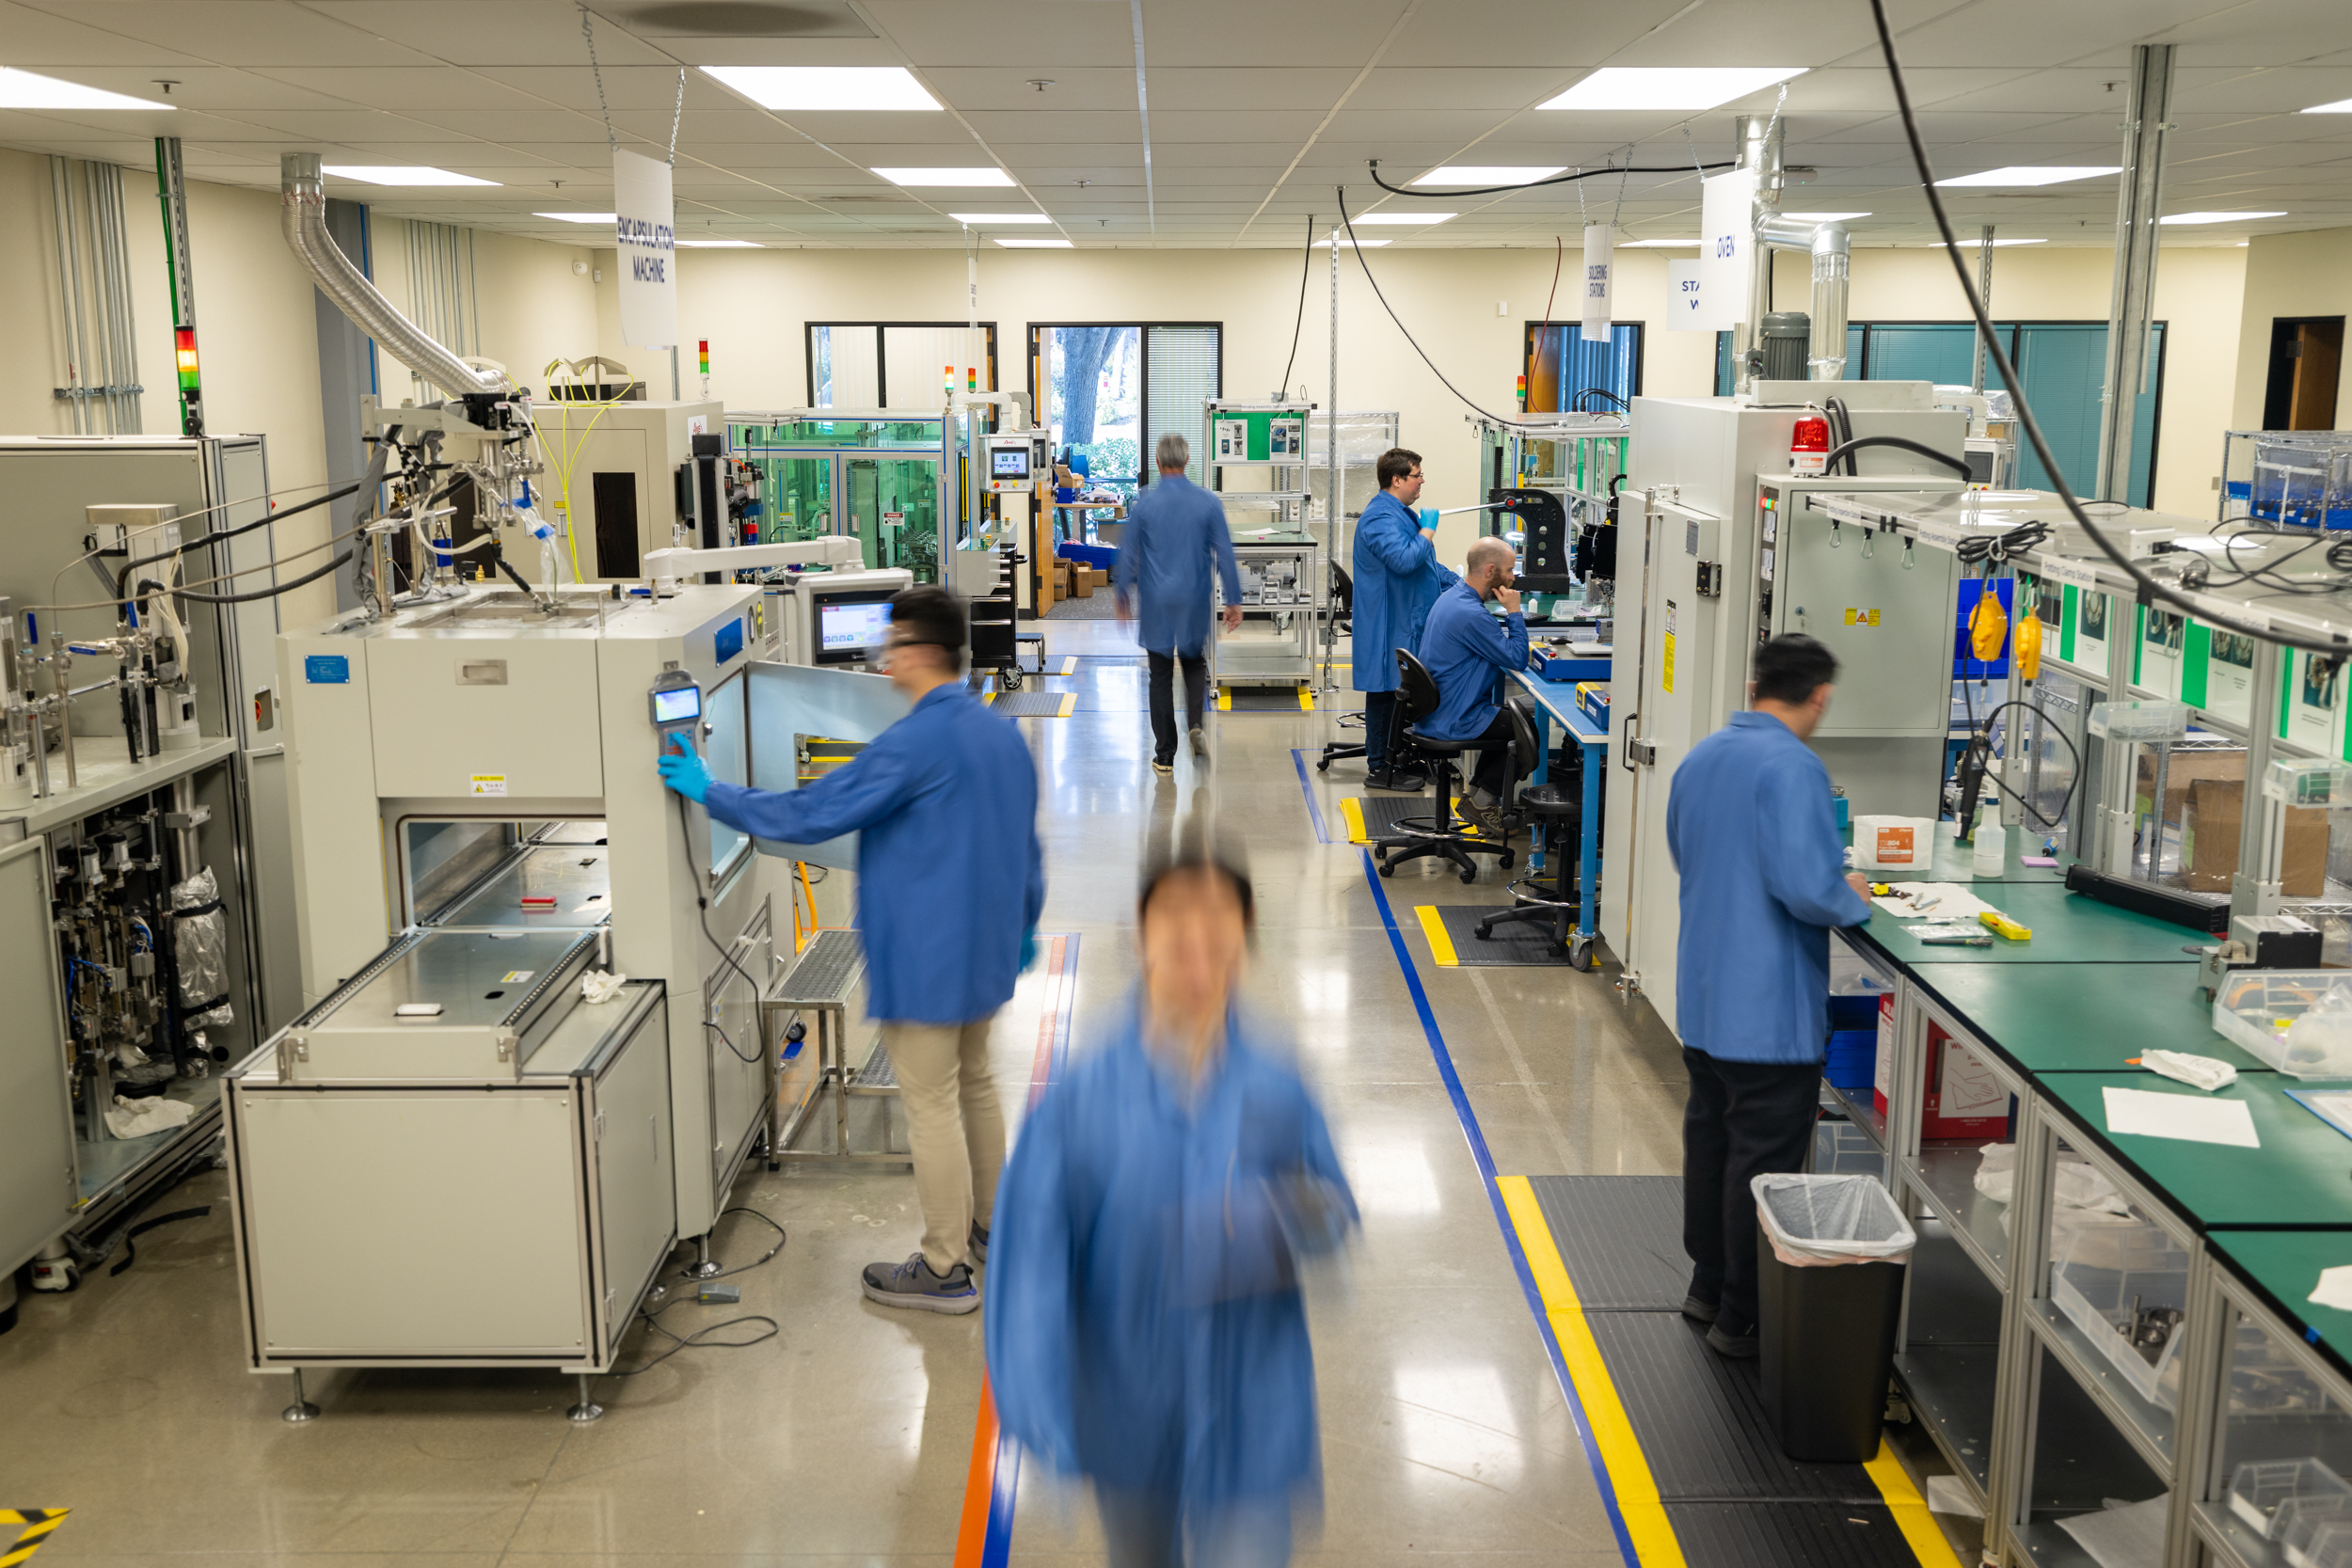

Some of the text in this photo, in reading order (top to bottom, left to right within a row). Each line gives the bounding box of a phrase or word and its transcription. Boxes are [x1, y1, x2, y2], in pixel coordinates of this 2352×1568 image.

[618, 216, 675, 251] ENCAPSULATION
[1717, 234, 1736, 259] OVEN
[633, 255, 665, 283] MACHINE
[1589, 264, 1607, 280] SOLDERING
[1589, 282, 1605, 298] STATIONS
